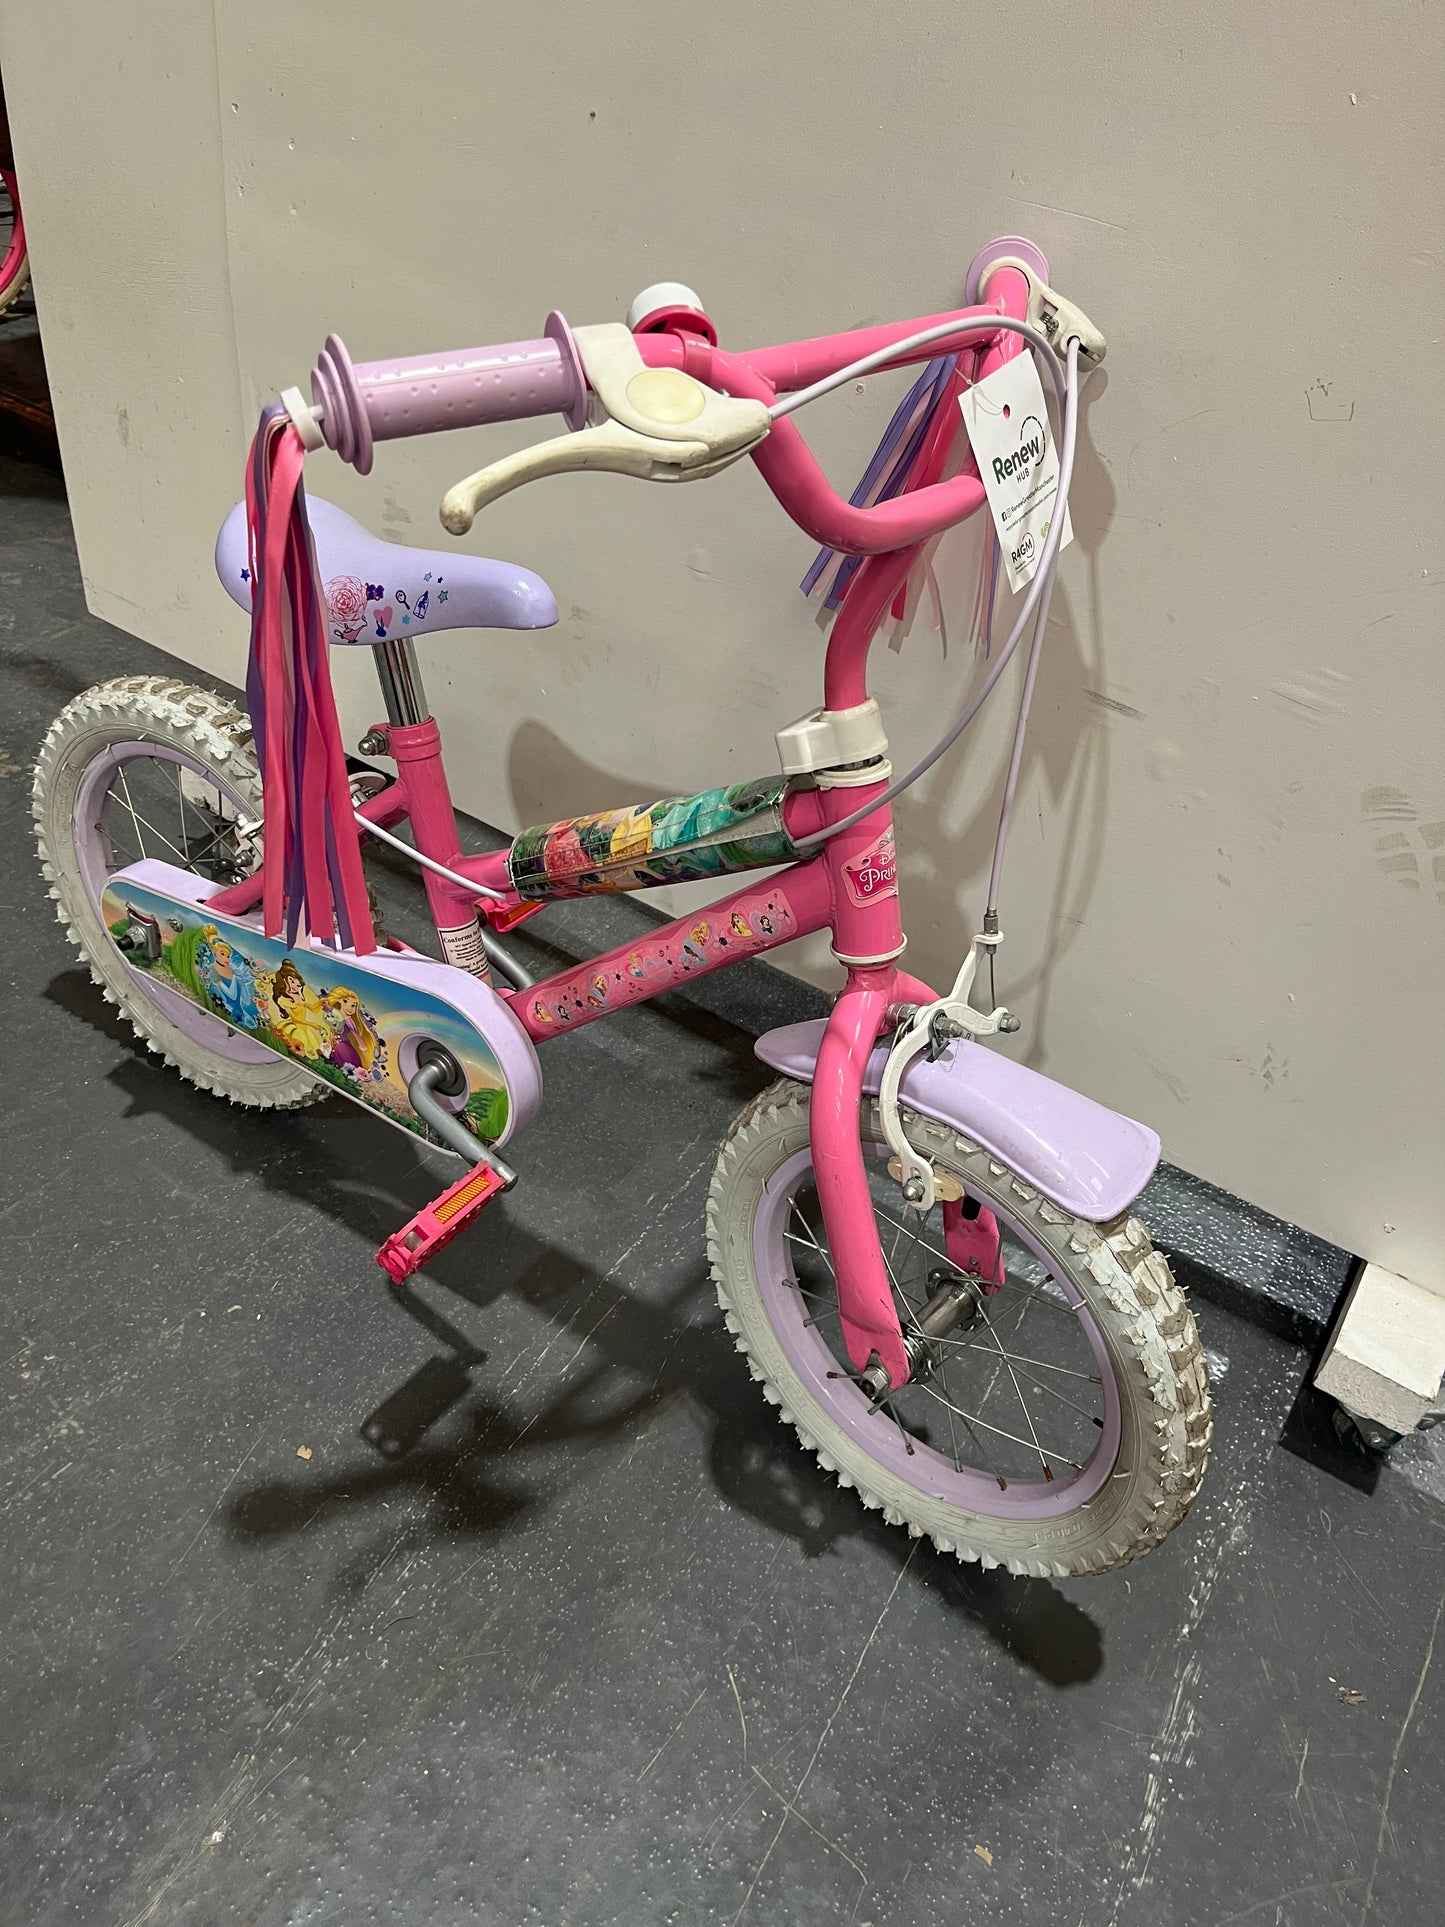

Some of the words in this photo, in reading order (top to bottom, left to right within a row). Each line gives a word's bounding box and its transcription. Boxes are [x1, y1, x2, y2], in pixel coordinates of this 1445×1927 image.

[991, 435, 1039, 484] Renew
[1016, 467, 1030, 484] HUB
[1011, 539, 1032, 563] R4GM
